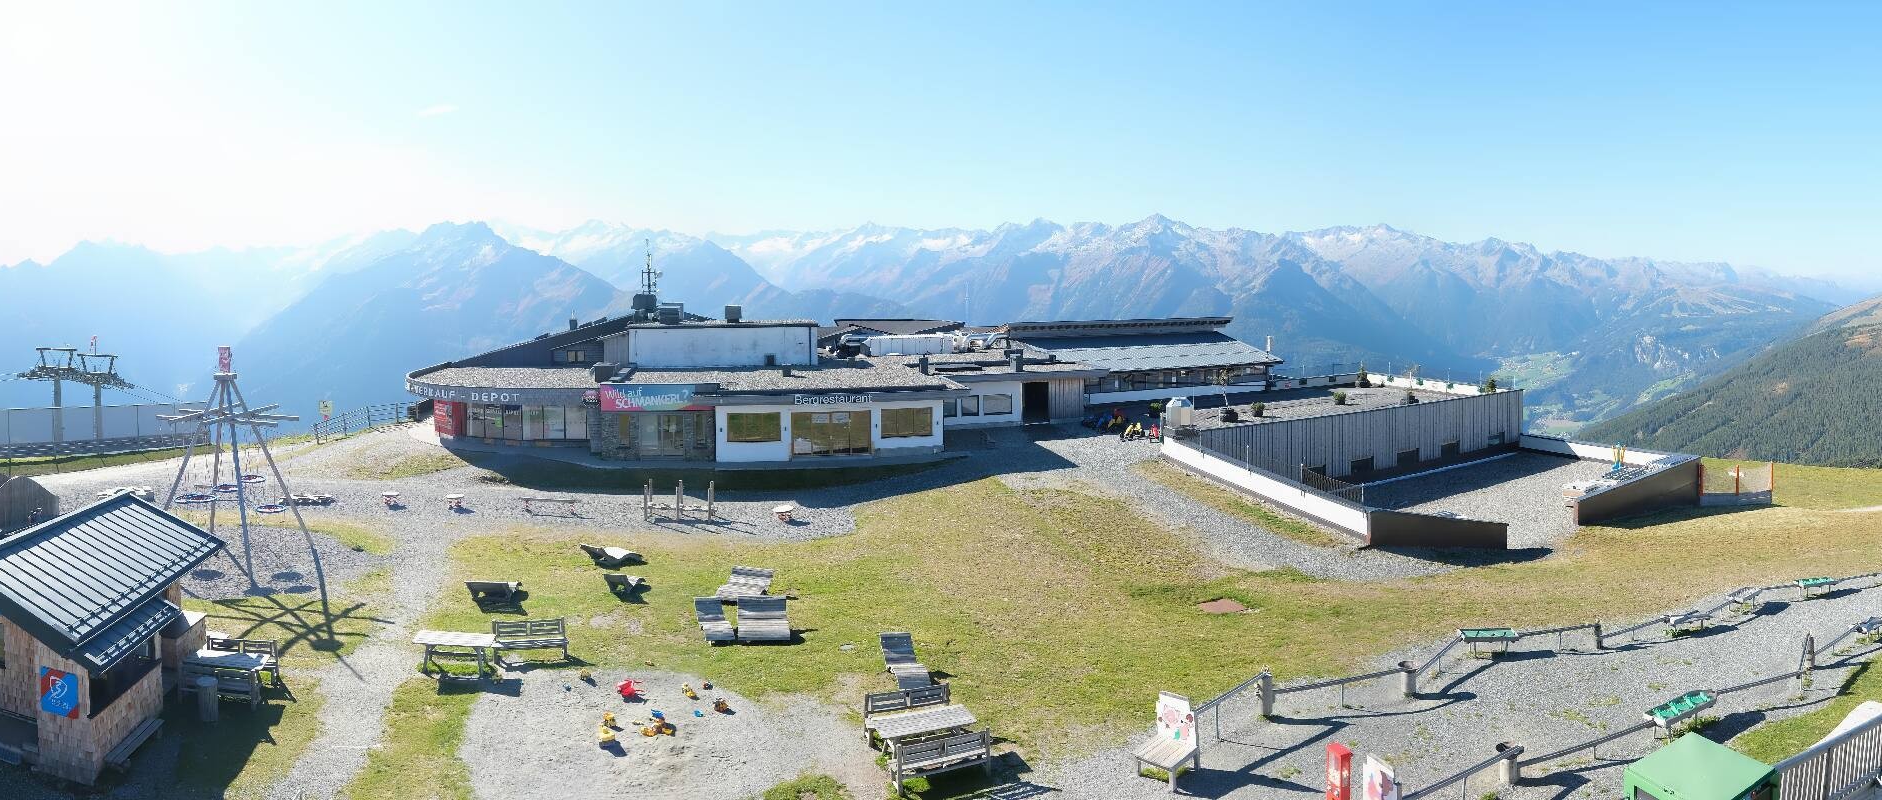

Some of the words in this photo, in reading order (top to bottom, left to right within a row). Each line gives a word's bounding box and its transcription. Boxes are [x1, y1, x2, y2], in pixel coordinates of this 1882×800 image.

[414, 386, 456, 399] VERKAUF
[471, 392, 520, 402] DEPOT
[628, 386, 642, 397] auf
[615, 389, 689, 409] SCHMANKERL?
[794, 394, 872, 406] Bergrestaurant
